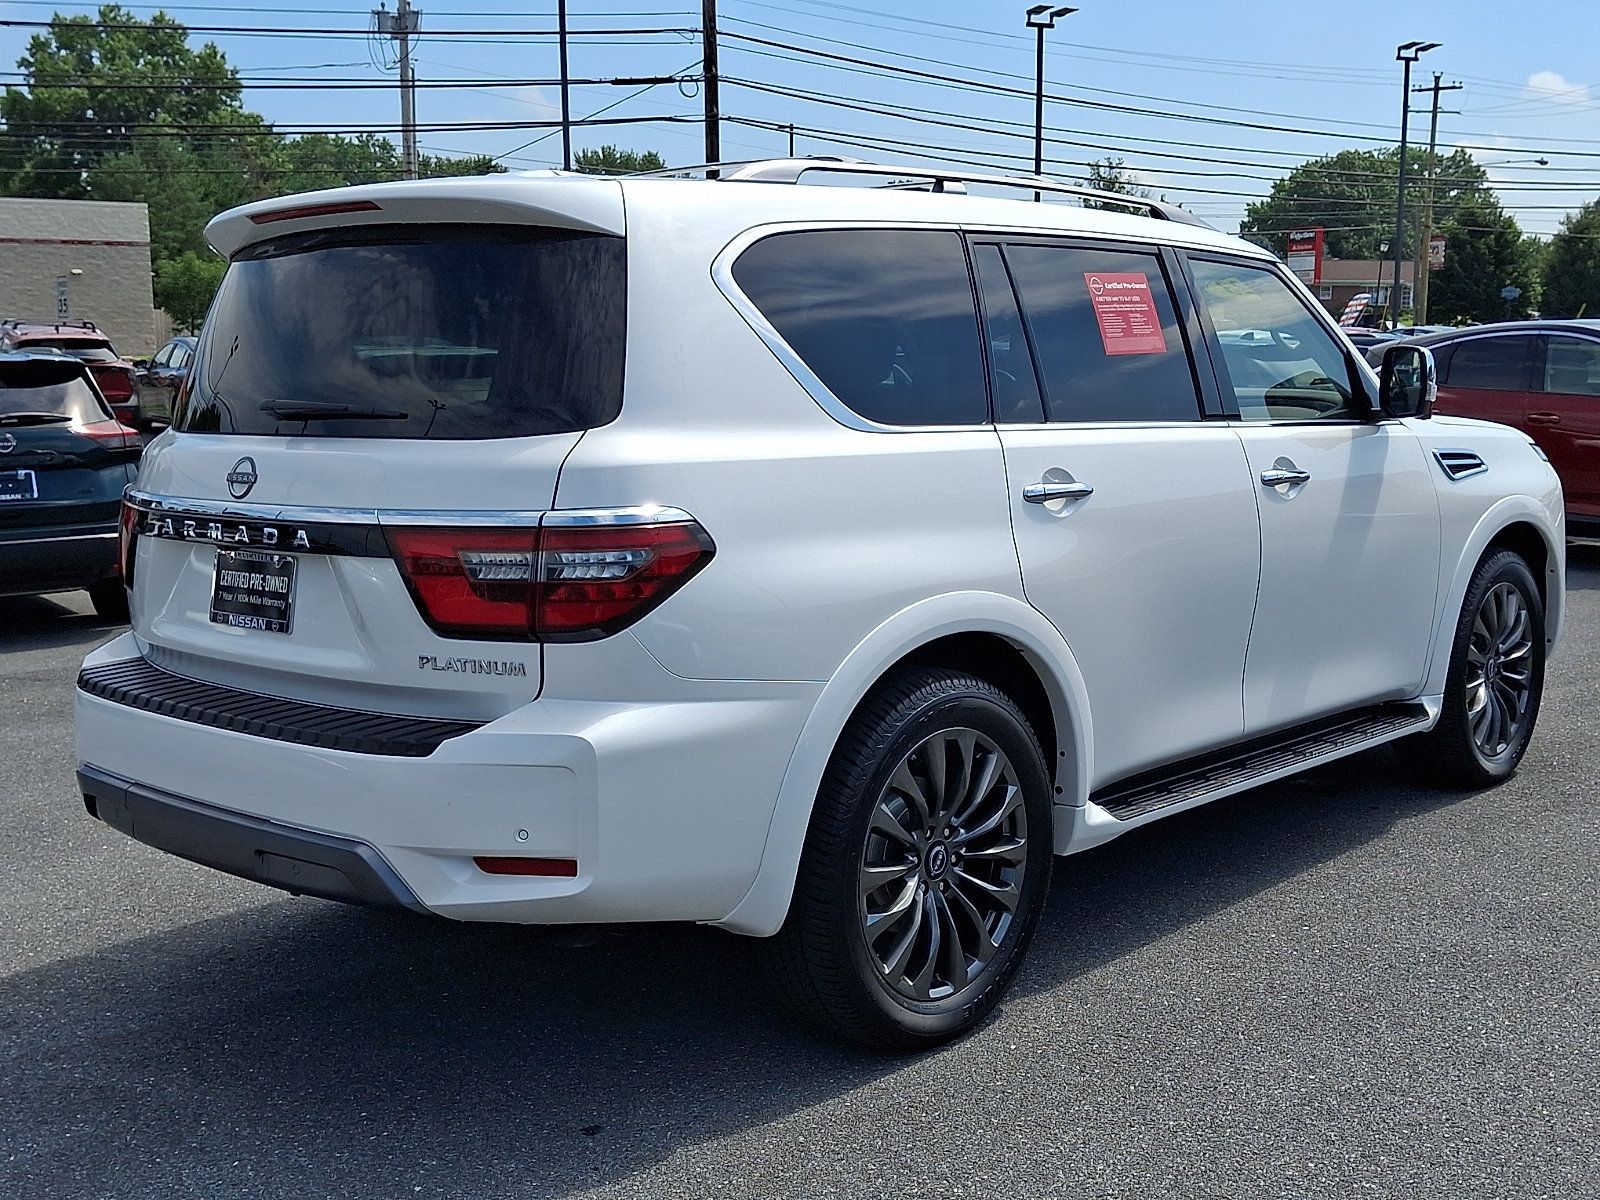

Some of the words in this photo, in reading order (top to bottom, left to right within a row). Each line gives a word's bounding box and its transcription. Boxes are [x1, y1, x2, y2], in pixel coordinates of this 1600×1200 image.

[162, 518, 310, 548] ARMADA
[220, 570, 250, 588] CERTIFIED
[250, 573, 289, 593] PRE-OWNED
[222, 592, 233, 601] Year
[237, 594, 250, 603] 100k
[250, 595, 262, 605] Mile
[262, 597, 286, 610] Warranty
[228, 614, 266, 630] NISSAN
[418, 655, 527, 676] PLATINUM
